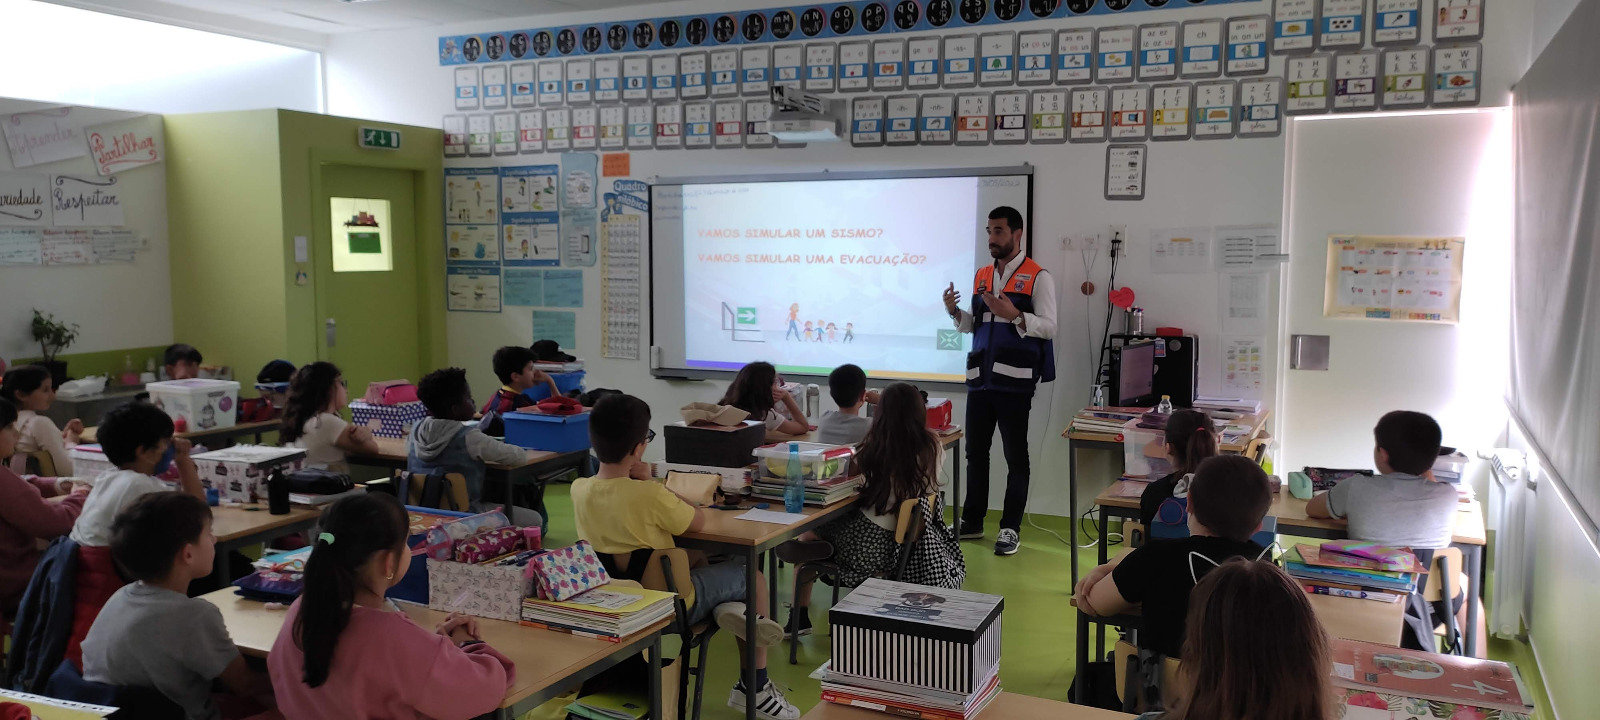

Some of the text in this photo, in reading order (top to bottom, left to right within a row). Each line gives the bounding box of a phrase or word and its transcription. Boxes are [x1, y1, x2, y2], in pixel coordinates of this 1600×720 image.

[90, 132, 156, 164] Partilhar
[614, 181, 647, 191] Quadro
[54, 188, 120, 221] Respeitar
[697, 228, 884, 238] VAMOS SIMULAR UM SISMO?
[697, 252, 927, 266] VAMOS SIMULAR UMA EVACUAÇÃO?
